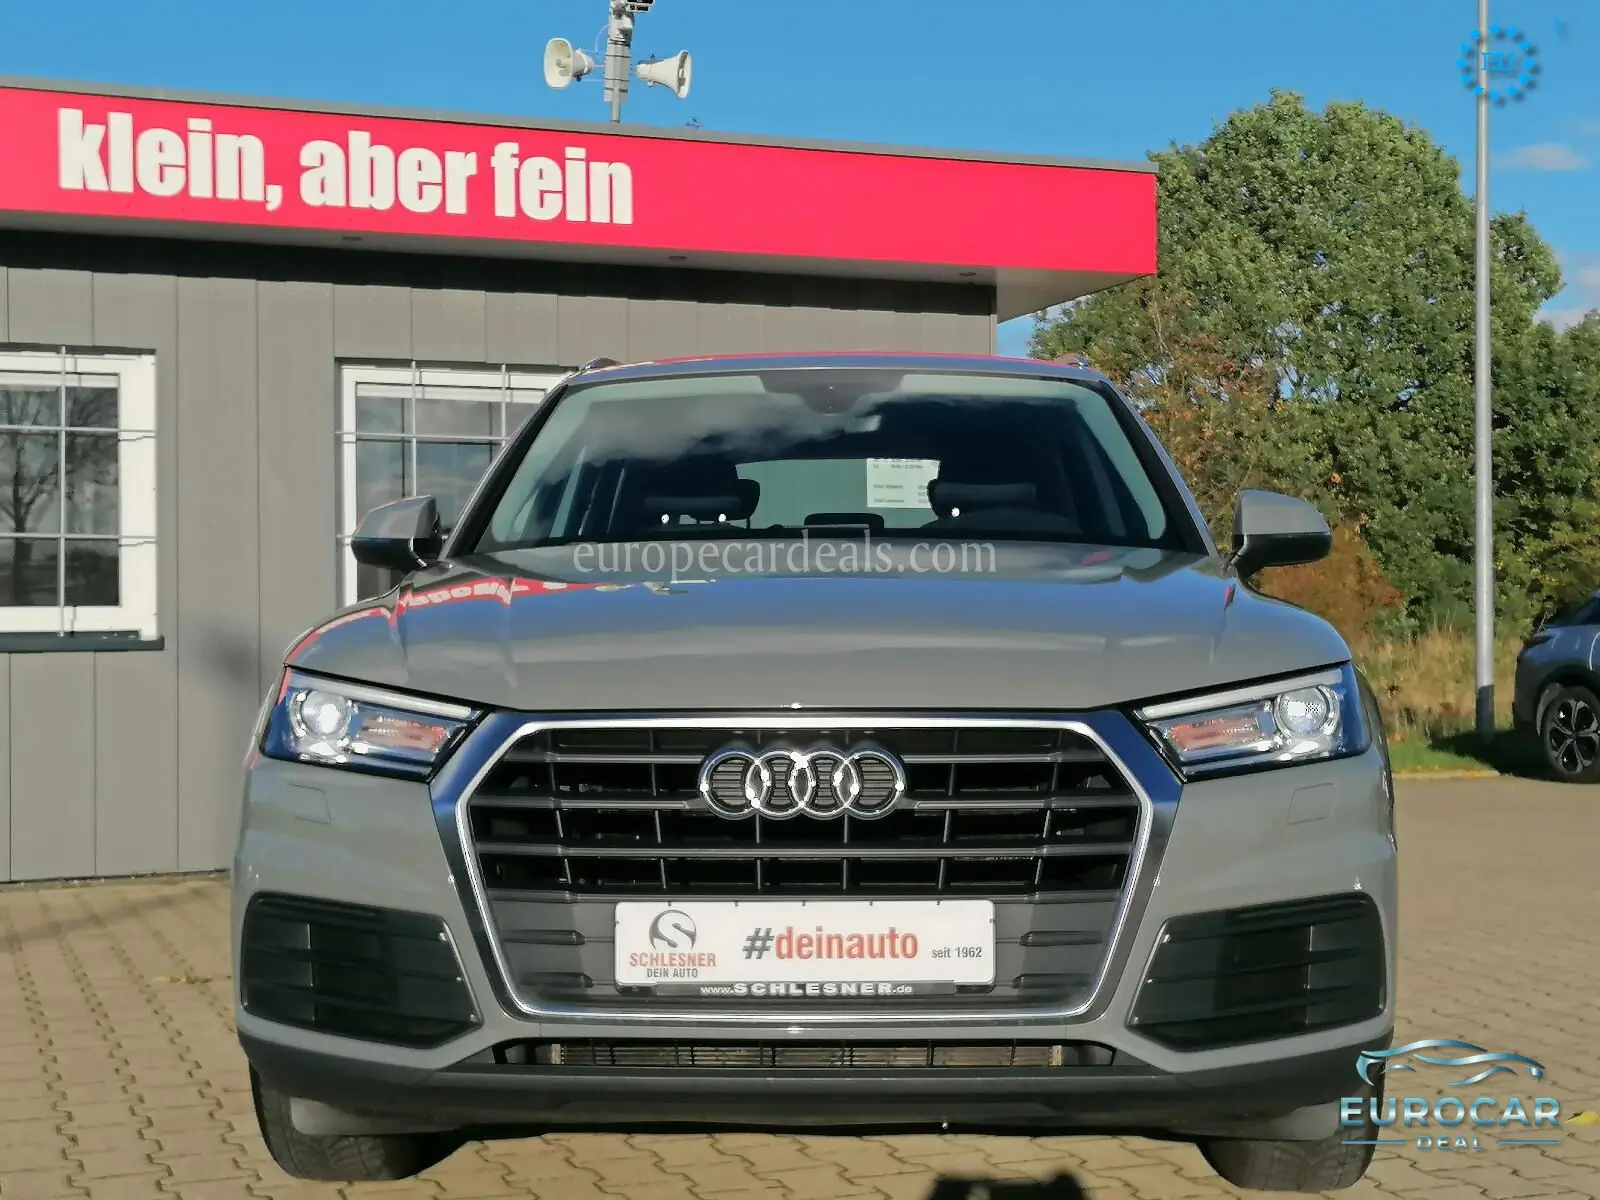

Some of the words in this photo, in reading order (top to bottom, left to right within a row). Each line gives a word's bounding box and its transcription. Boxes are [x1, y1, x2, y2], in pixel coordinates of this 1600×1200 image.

[58, 108, 282, 211] klein,
[300, 130, 477, 215] aber
[490, 142, 633, 225] fein
[742, 926, 919, 960] #deinauto
[932, 947, 951, 958] seit
[954, 946, 983, 958] 1962
[629, 952, 717, 967] SCHLESNER
[646, 967, 669, 978] DEIN
[672, 967, 699, 978] AUTO
[700, 983, 913, 996] www.SCHLESNER.de
